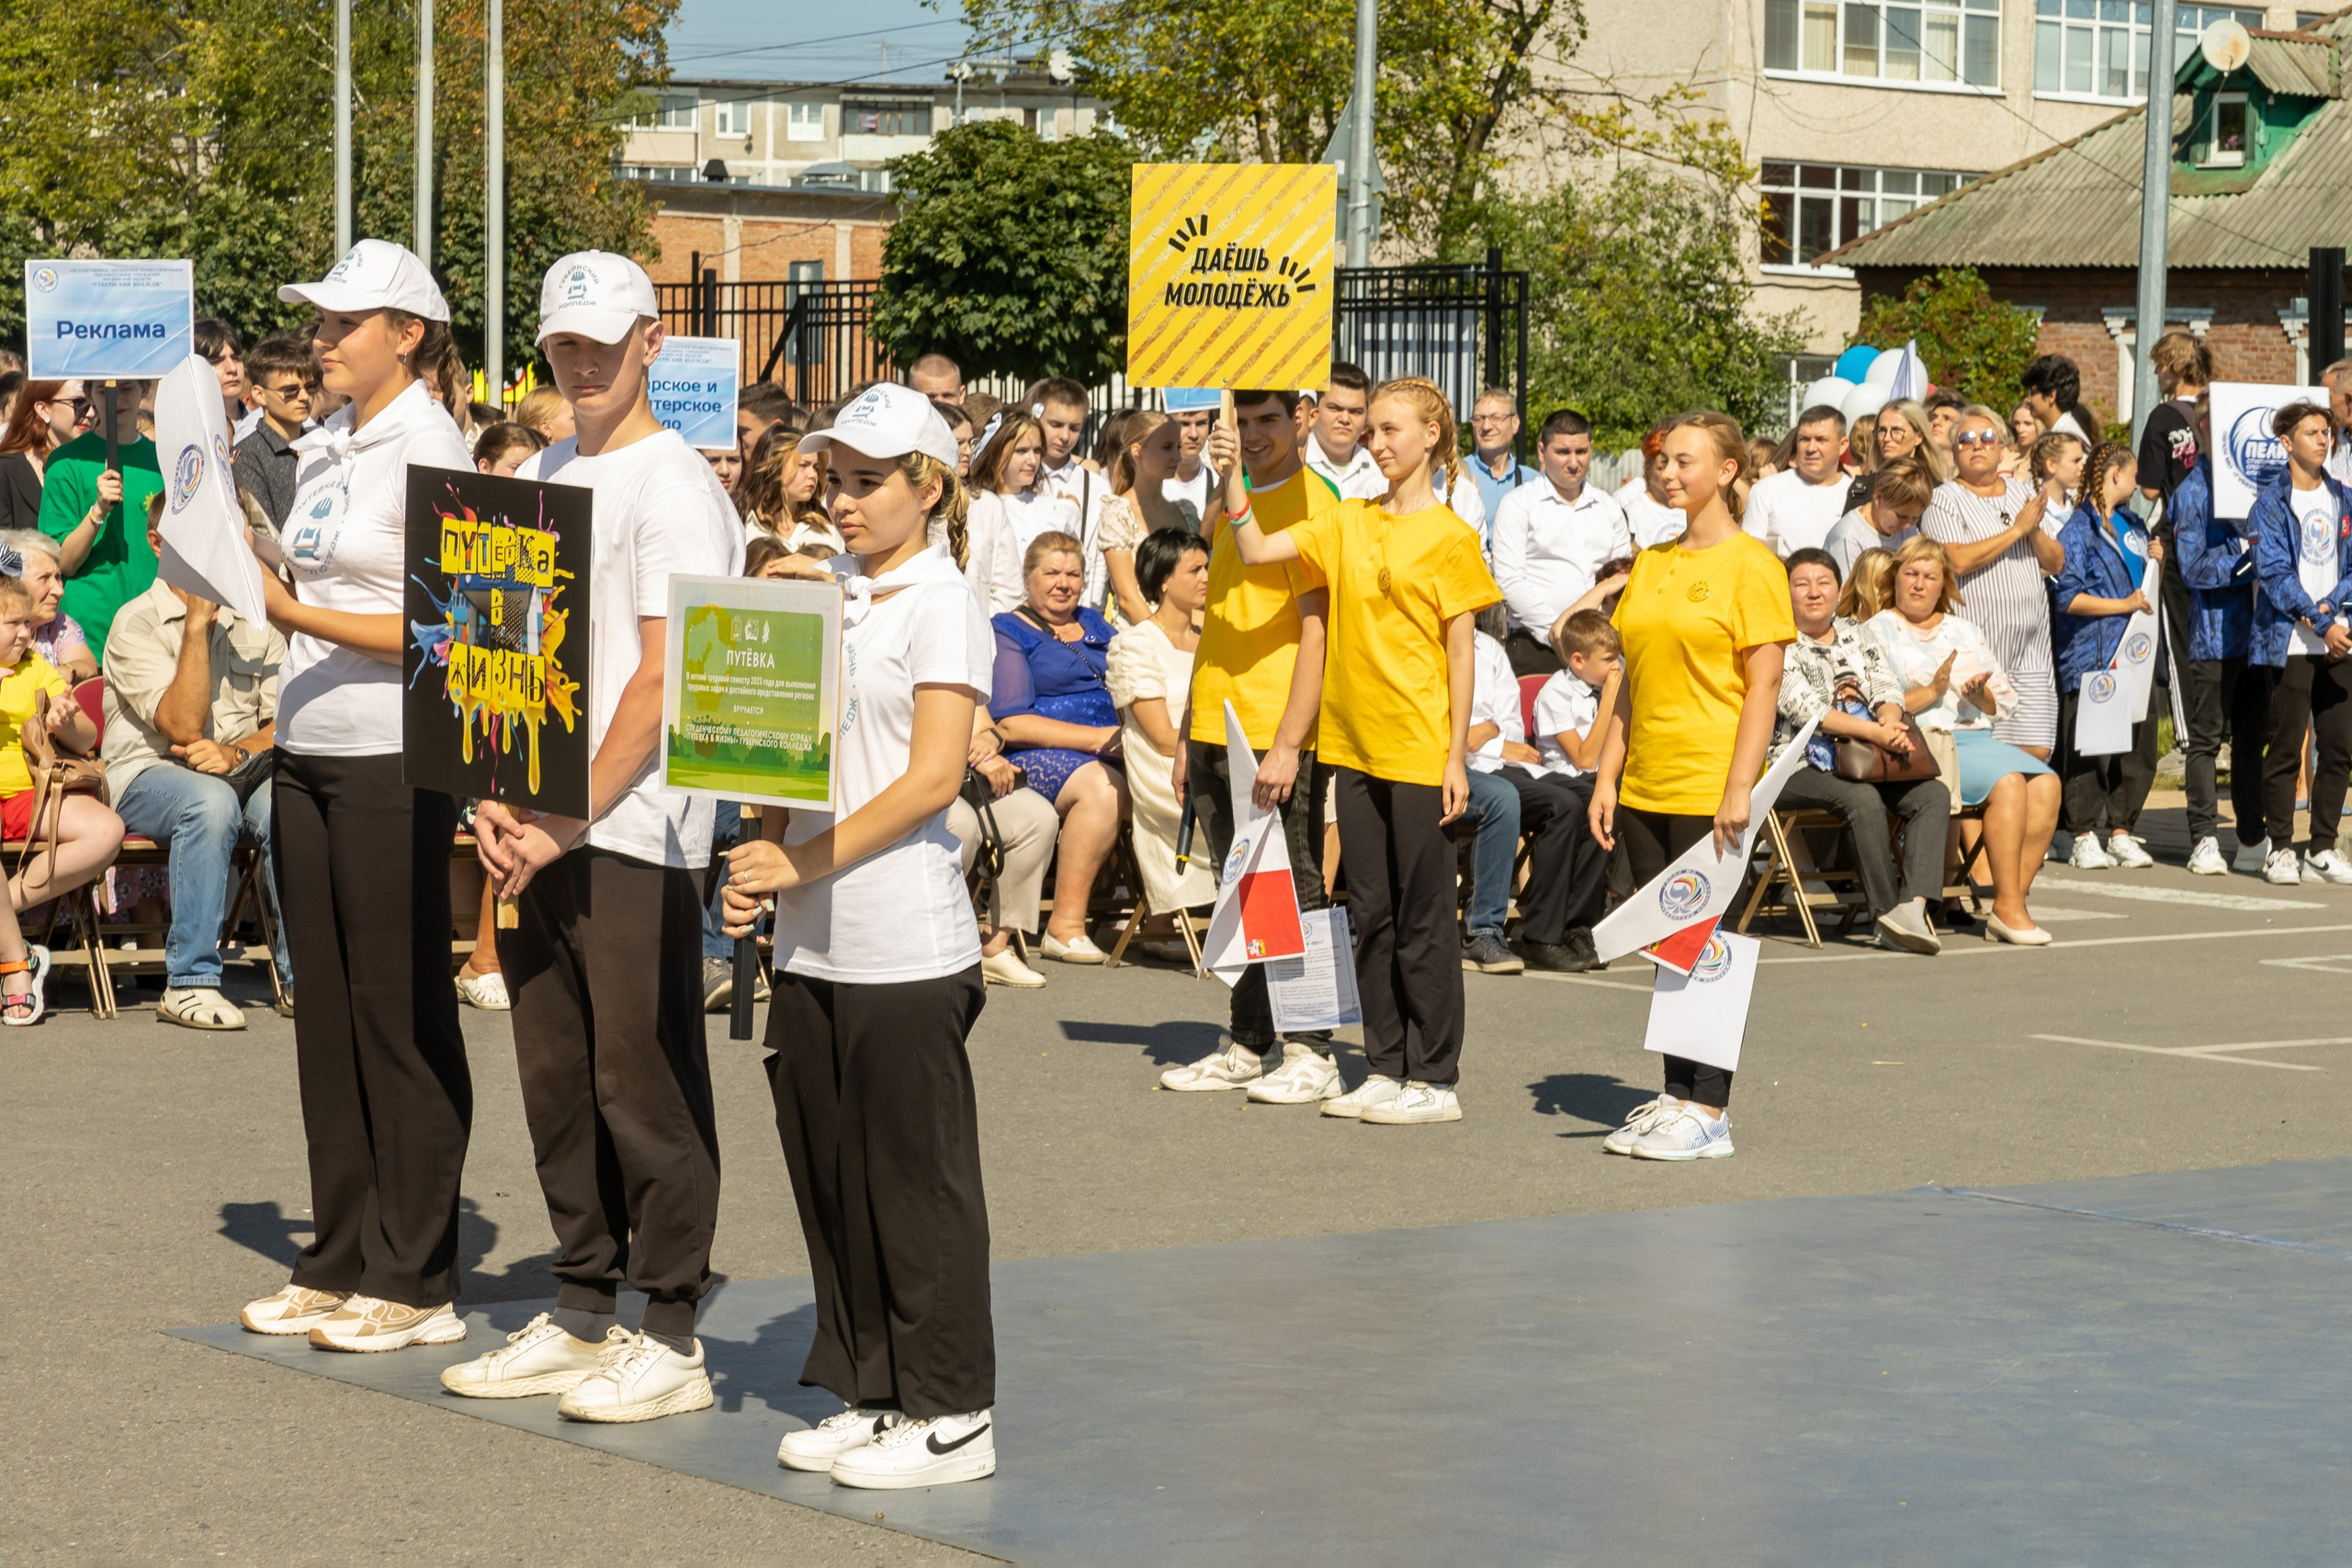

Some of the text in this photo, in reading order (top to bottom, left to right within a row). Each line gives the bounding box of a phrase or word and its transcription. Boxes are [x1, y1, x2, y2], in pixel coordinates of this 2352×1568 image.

[1191, 243, 1270, 274] ДАЁШЬ
[1164, 278, 1291, 309] МОЛОДЁЖЬ
[559, 300, 596, 310] КОЛЛЕДЖ
[57, 321, 164, 339] Реклама
[707, 382, 717, 393] и
[727, 648, 775, 669] ПУТЁВКА
[451, 648, 544, 703] ЖИЗНЬ
[691, 672, 707, 682] летний
[707, 674, 730, 684] трудовой
[730, 676, 750, 685] семестр
[751, 676, 762, 684] 2023
[763, 679, 775, 687] года
[775, 680, 785, 688] для
[786, 682, 816, 690] выполнения
[687, 683, 709, 693] трудовых
[710, 685, 724, 694] задач
[729, 686, 756, 695] достойного
[757, 689, 794, 698] представления
[794, 692, 814, 701] региона
[733, 705, 763, 716] ВРУЧАЕТСЯ
[685, 724, 813, 742] СТУДЕНЧЕСКОМУ ПЕДАГОГИЧЕСКОМУ ОТРЯДУ
[740, 737, 778, 749] ГУБЕРНСКОГО
[779, 740, 813, 751] КОЛЛЕДЖА
